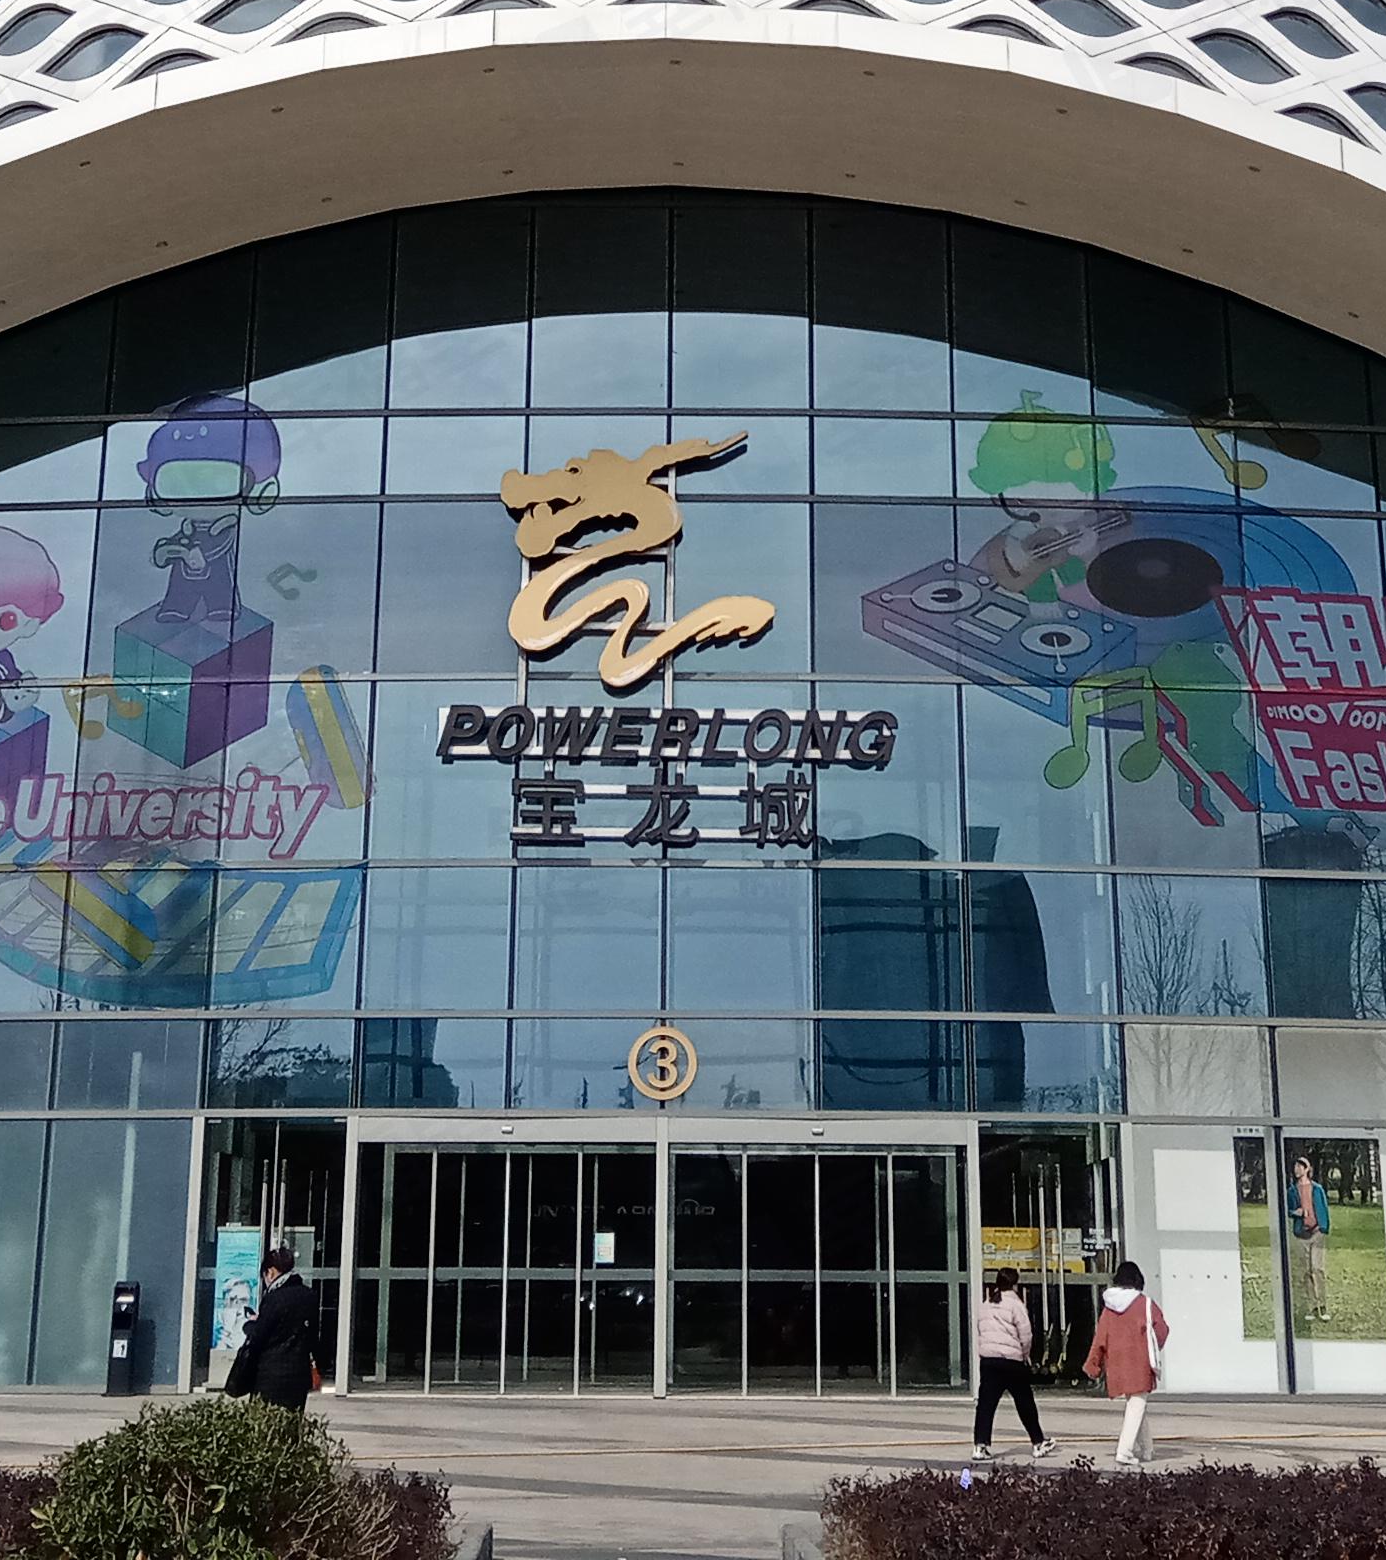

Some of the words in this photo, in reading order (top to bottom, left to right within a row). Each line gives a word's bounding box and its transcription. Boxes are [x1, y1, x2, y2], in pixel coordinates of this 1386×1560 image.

[436, 703, 900, 771] POWERLONG
[13, 767, 330, 860] University
[513, 769, 816, 848] 宝龙城
